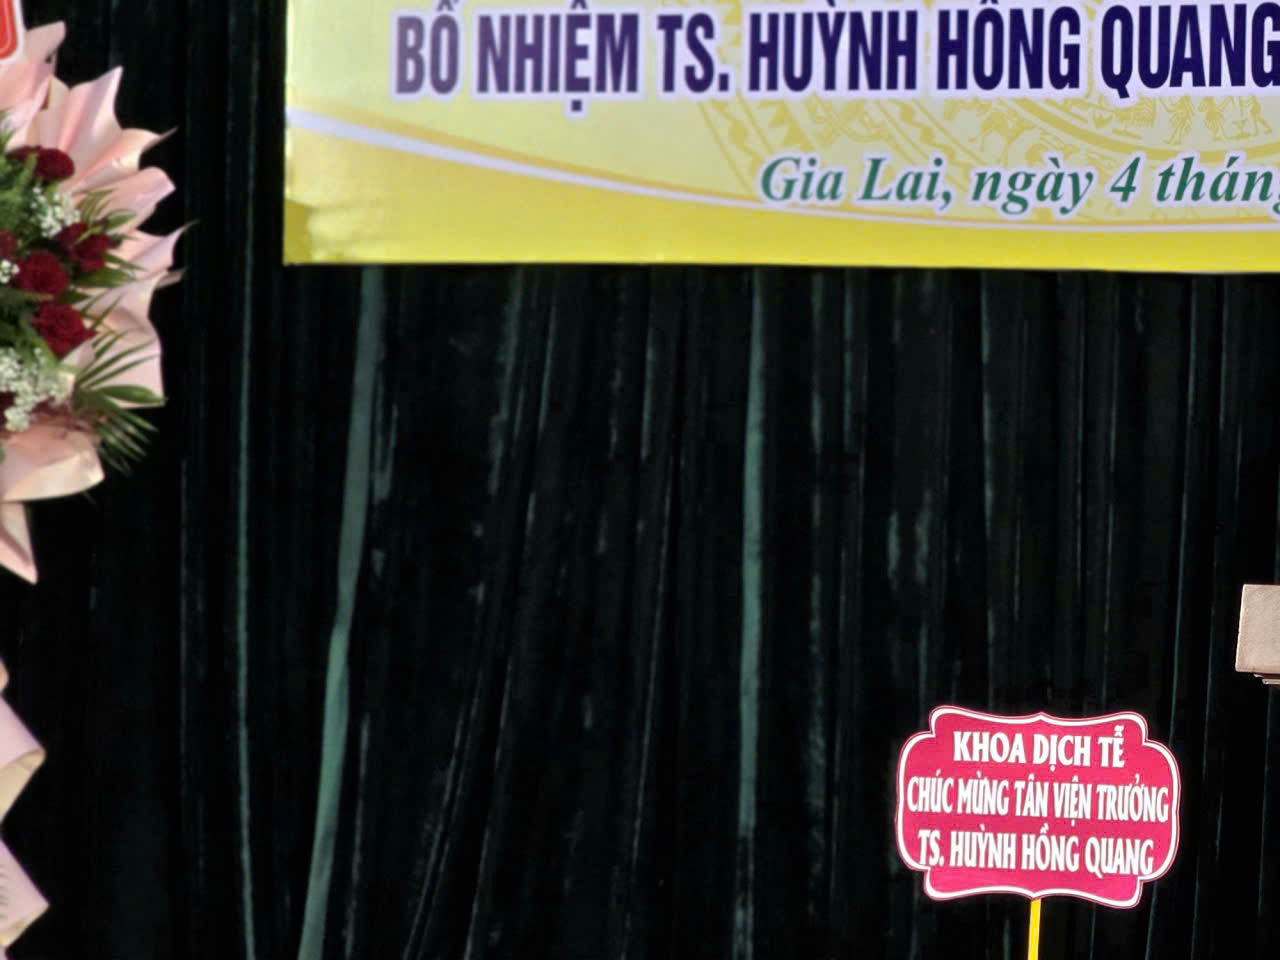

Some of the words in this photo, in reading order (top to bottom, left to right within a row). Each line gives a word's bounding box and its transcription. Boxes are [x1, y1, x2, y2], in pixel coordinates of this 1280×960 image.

[658, 14, 728, 92] TS.
[762, 158, 842, 200] Gia
[862, 158, 951, 205] Lai,
[973, 158, 1093, 214] ngày
[1111, 157, 1140, 201] 4
[954, 731, 1026, 763] KHOA
[1033, 734, 1091, 771] DỊCH
[1098, 725, 1124, 767] TỄ
[907, 770, 954, 813] CHÚC
[957, 771, 1009, 815] MỪNG
[1014, 774, 1049, 817] TÂN
[1053, 776, 1092, 826] VIỆN
[1096, 774, 1168, 822] TRƯỞNG
[918, 829, 944, 866] TS.
[949, 824, 1016, 869] HUỲNH
[1021, 823, 1079, 872] HỒNG
[1085, 837, 1154, 878] QUANG
